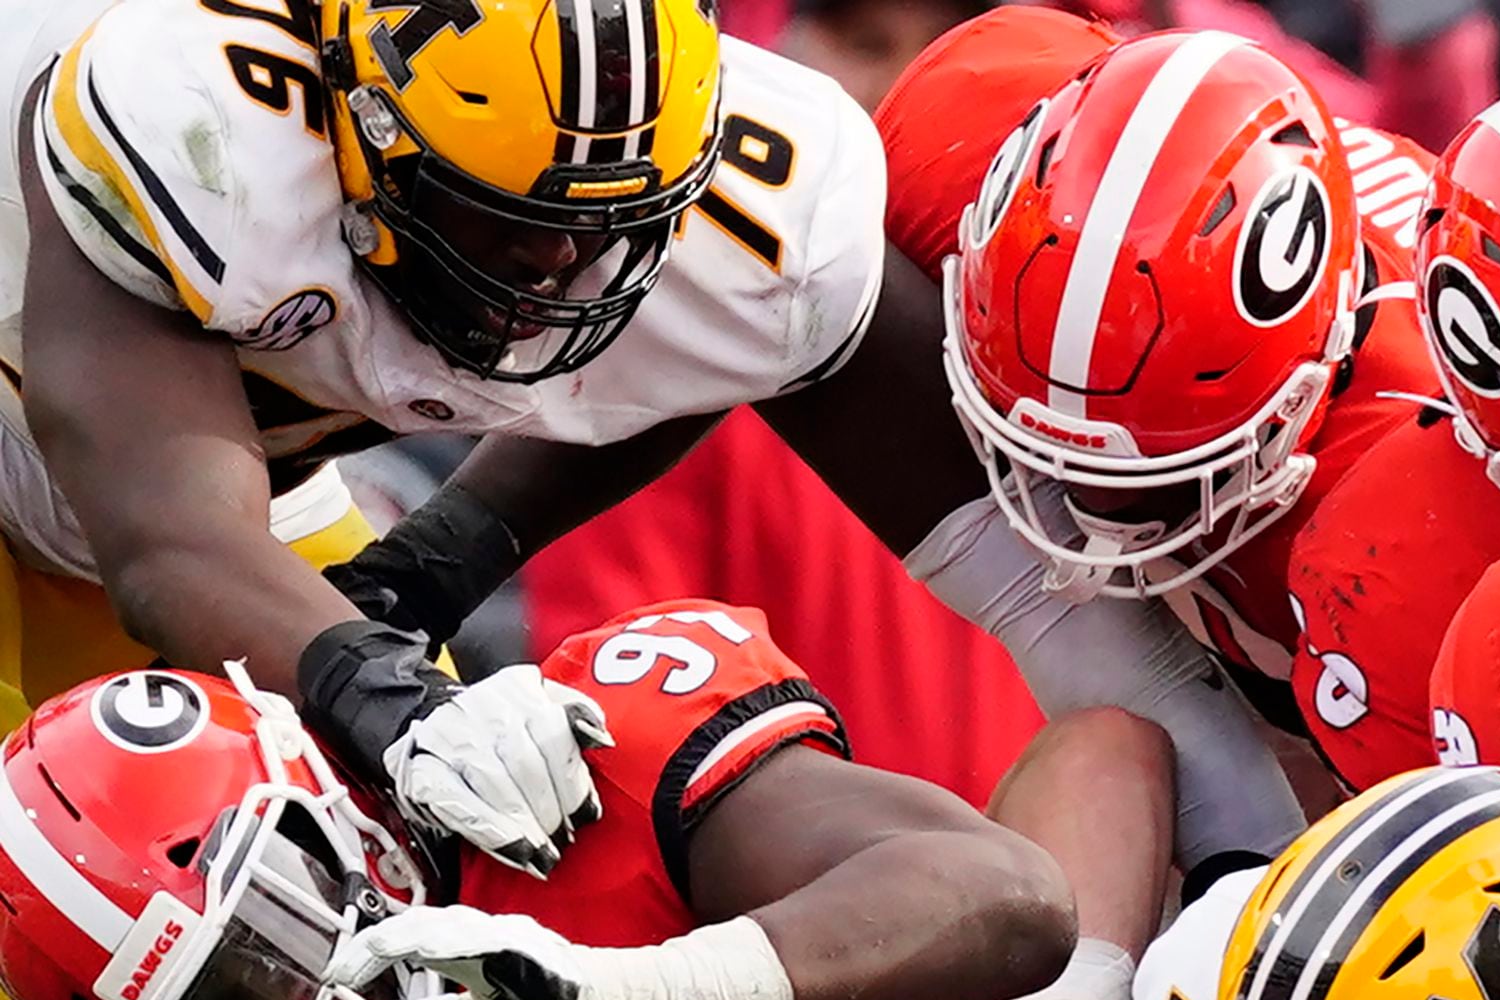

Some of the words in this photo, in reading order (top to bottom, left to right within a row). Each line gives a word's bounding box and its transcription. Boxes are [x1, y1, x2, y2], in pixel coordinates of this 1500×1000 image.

[1233, 165, 1331, 326] G
[592, 610, 756, 696] 97
[92, 671, 209, 753] G
